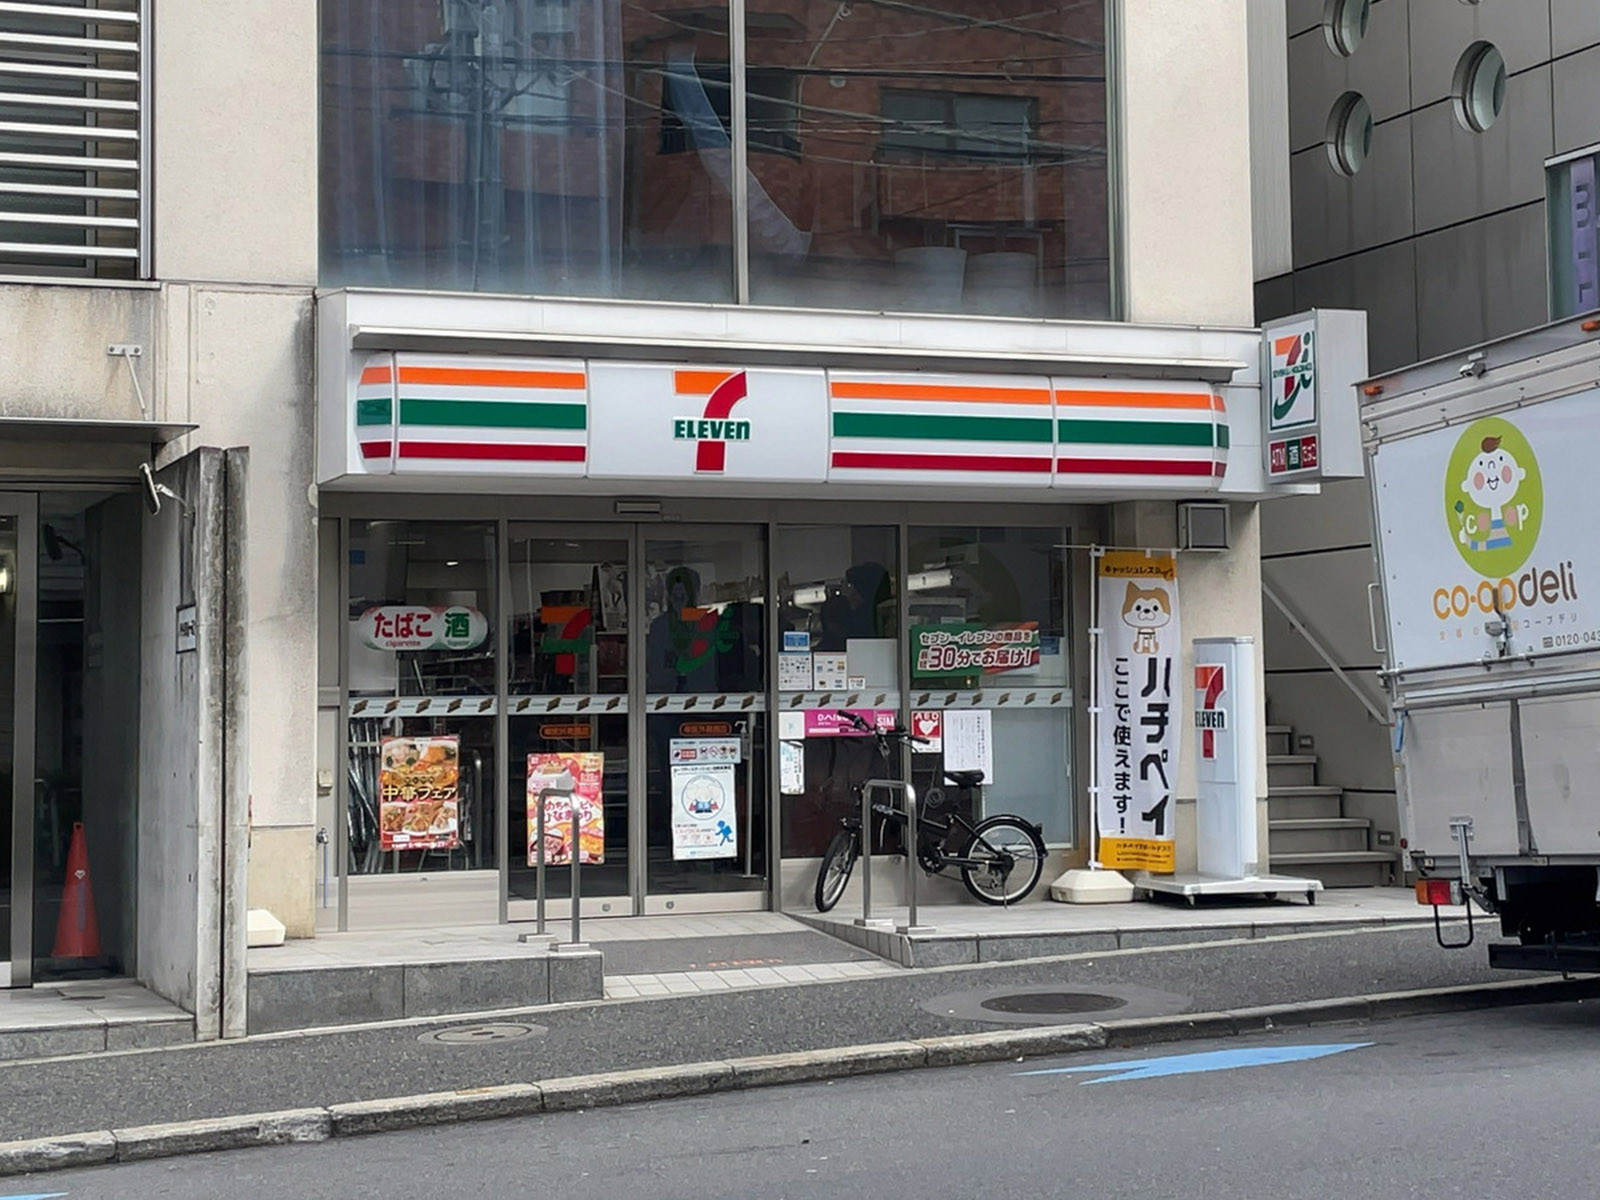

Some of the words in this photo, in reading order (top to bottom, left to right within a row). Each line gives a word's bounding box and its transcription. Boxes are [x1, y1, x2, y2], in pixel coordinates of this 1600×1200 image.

[674, 370, 748, 471] 7
[374, 612, 433, 638] たばこ
[445, 613, 470, 638] 酒
[1523, 612, 1579, 629] コープデリ
[876, 715, 895, 728] SIM
[914, 712, 939, 721] AED
[1140, 657, 1171, 836] ハチペイ
[382, 784, 457, 802] 中華フェア
